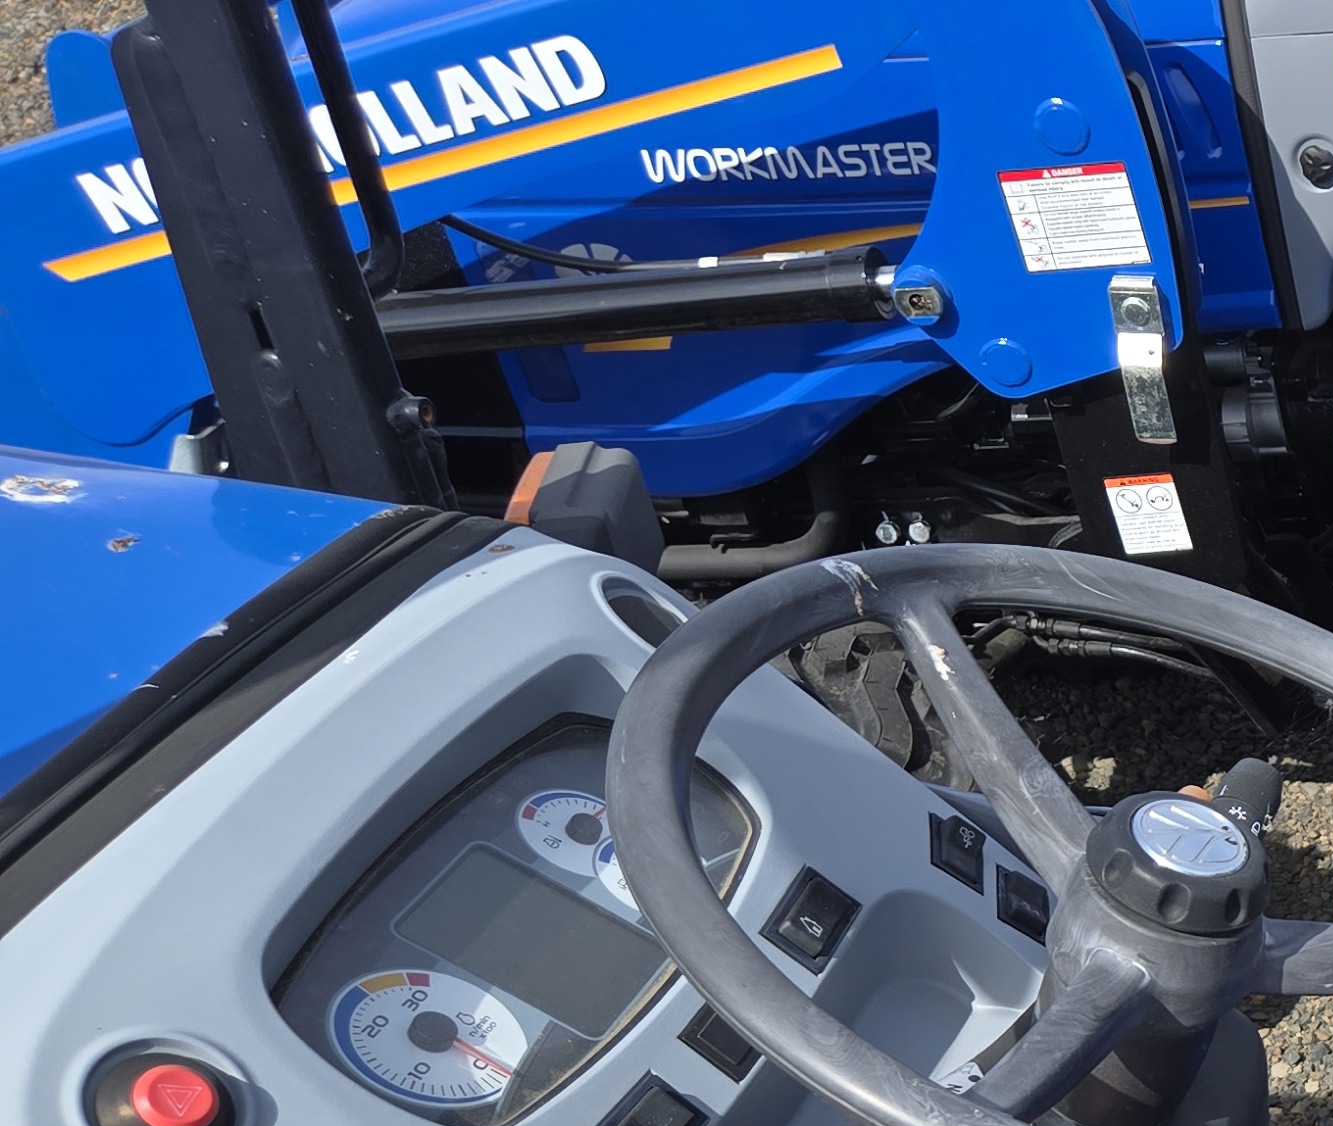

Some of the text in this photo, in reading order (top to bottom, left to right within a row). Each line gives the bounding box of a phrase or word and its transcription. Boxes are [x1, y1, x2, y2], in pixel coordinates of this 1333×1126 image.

[640, 141, 937, 183] WORKMASTER
[1052, 167, 1083, 177] DANGER
[401, 989, 429, 1012] 30
[361, 1015, 389, 1039] 20
[469, 1014, 491, 1038] n/min
[406, 1061, 431, 1081] 10
